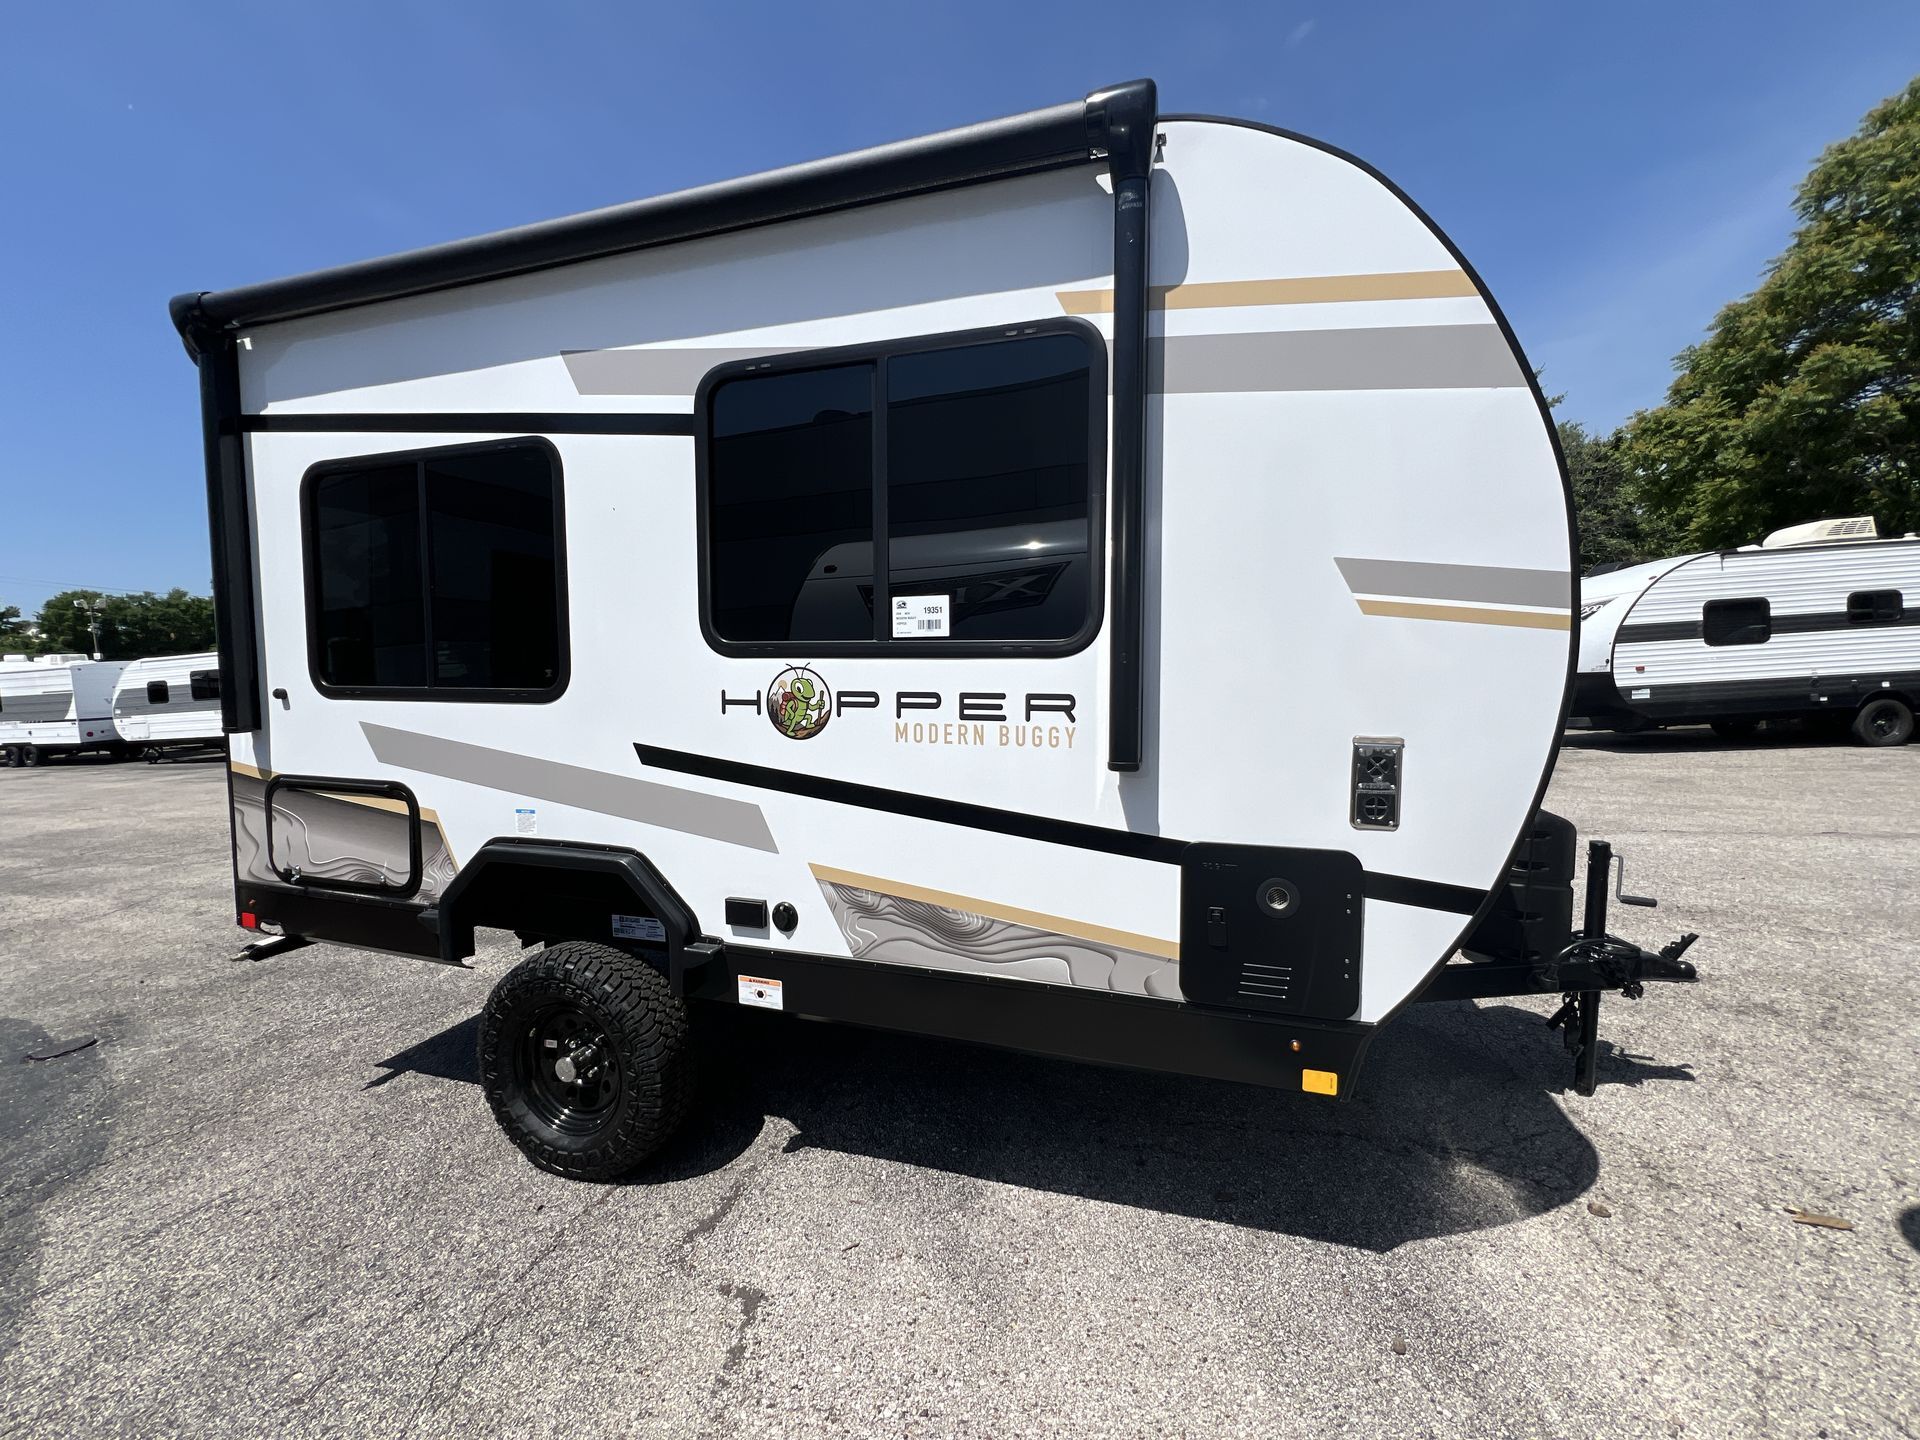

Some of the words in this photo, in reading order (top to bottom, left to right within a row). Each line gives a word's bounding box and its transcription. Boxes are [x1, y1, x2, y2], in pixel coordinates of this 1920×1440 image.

[923, 606, 943, 614] 19351
[895, 722, 985, 746] MODERN
[1000, 725, 1077, 749] BUGGY
